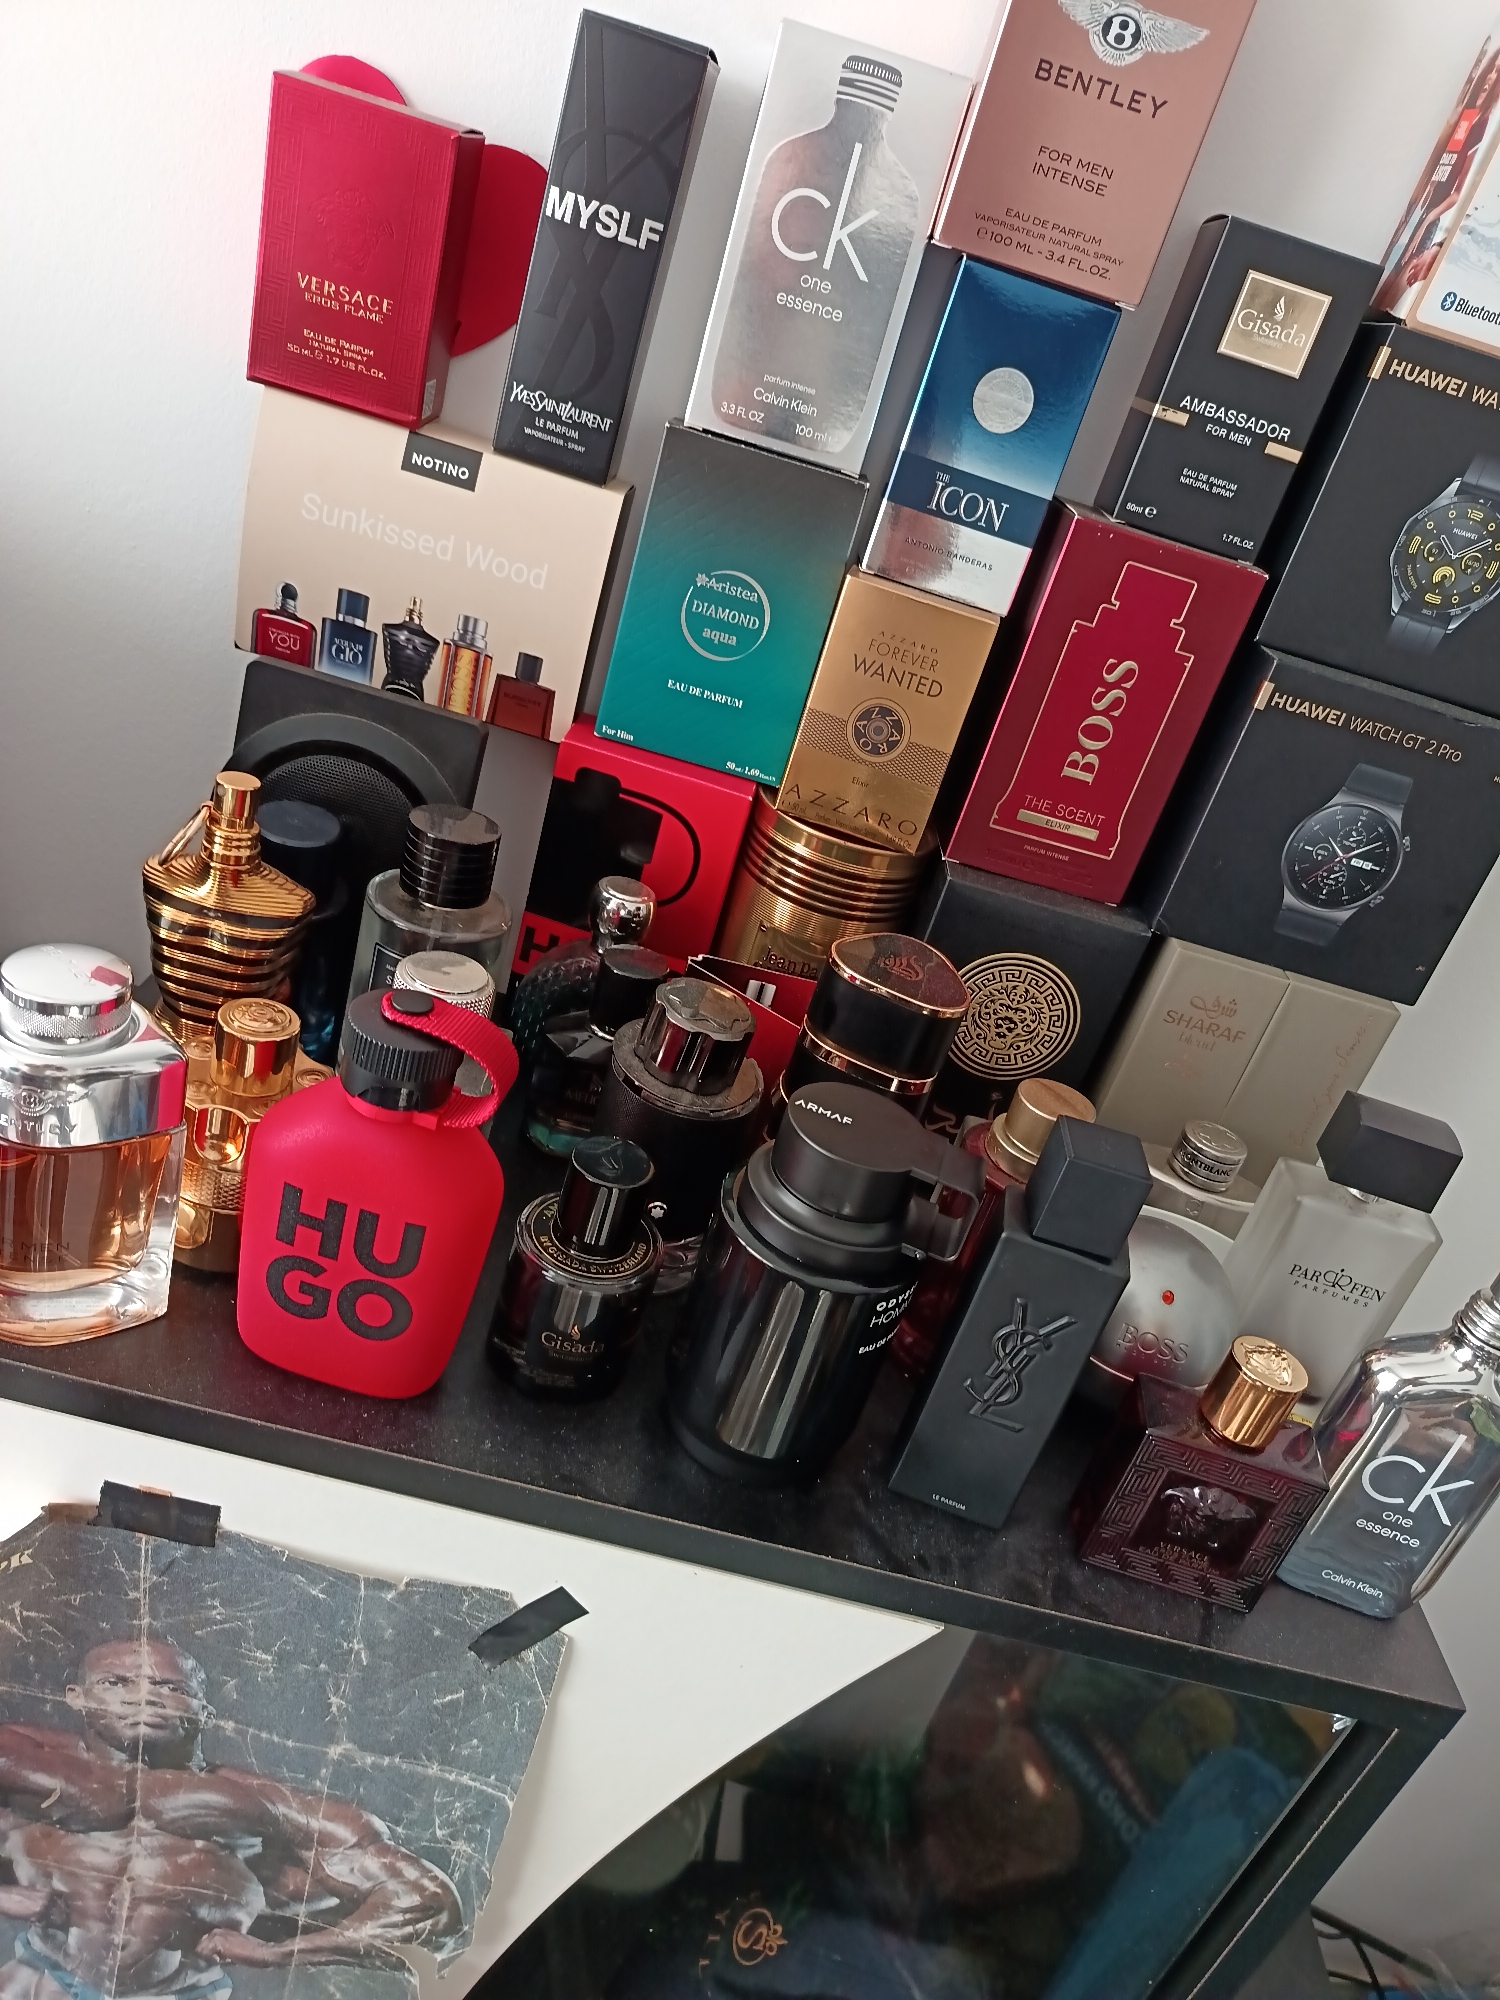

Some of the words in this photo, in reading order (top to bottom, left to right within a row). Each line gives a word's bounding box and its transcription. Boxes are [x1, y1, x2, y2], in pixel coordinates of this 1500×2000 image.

[1034, 58, 1168, 119] BENTLEY
[1037, 145, 1072, 167] FOR
[1076, 158, 1114, 180] MEN
[1032, 161, 1108, 197] INTENSE
[545, 184, 664, 251] MYSLF
[1005, 207, 1030, 223] EAU
[1032, 216, 1050, 230] DE
[1051, 222, 1102, 247] PARFUM
[974, 211, 1046, 242] VAPORISATEUR
[1048, 236, 1091, 258] NATURAL
[1093, 251, 1124, 267] SPRAY
[989, 230, 1013, 247] 100
[1015, 239, 1034, 255] ML
[1044, 249, 1065, 266] 3.4
[297, 271, 394, 316] VERSACE
[800, 274, 832, 294] one
[305, 291, 340, 311] EROS
[344, 304, 384, 325] FLAME
[776, 291, 843, 322] essence
[1454, 297, 1500, 326] Bluetoot
[304, 328, 322, 341] EAU
[324, 334, 337, 346] DE
[340, 338, 374, 358] PARFUM
[1237, 307, 1307, 349] Gisada
[287, 342, 300, 354] 50
[326, 354, 340, 367] 1.7
[341, 358, 356, 371] US
[764, 373, 790, 390] parfum
[790, 380, 816, 396] intense
[1389, 358, 1468, 398] HUAWEI
[1471, 385, 1500, 411] WA
[720, 401, 736, 415] 3.3
[737, 405, 748, 419] FL
[748, 410, 765, 424] OZ
[753, 386, 790, 411] Calvin
[790, 396, 818, 418] Klein
[535, 416, 545, 428] LE
[546, 420, 579, 440] PARFUM
[795, 423, 813, 438] 100
[814, 429, 827, 443] ml
[1179, 395, 1291, 443] AMBASSADOR
[1205, 423, 1228, 440] FOR
[1228, 431, 1252, 447] MEN
[411, 451, 470, 480] NOTINO
[935, 470, 951, 484] THE
[1182, 467, 1198, 479] EAU
[1198, 472, 1209, 482] DE
[1209, 475, 1238, 492] PARFUM
[1179, 475, 1210, 493] NATURAL
[1211, 485, 1235, 500] SPRAY
[926, 480, 1010, 533] ICON
[301, 492, 455, 562] Sunkissed
[465, 540, 549, 591] Wood
[1221, 533, 1233, 544] 1.7
[1452, 527, 1478, 541] HUAWEI
[905, 536, 945, 555] ANTONIO
[946, 550, 993, 572] BANDERAS
[706, 576, 759, 604] Aristea
[691, 599, 760, 630] DIAMOND
[269, 629, 301, 652] YOU
[702, 627, 737, 647] aqua
[878, 630, 938, 655] AZZARO
[868, 638, 939, 673] FOREVER
[853, 653, 943, 698] WANTED
[667, 679, 688, 693] EAU
[688, 685, 702, 698] DE
[703, 688, 743, 709] PARFUM
[602, 724, 616, 736] For
[617, 729, 634, 742] Him
[1061, 659, 1139, 786] BOSS
[1271, 692, 1347, 727] HUAWEI
[1349, 715, 1402, 744] WATCH
[1403, 733, 1425, 750] GT
[1425, 740, 1437, 755] 2
[1437, 743, 1462, 763] Pro
[851, 776, 870, 789] Elixir
[784, 783, 918, 836] AZZARO
[1024, 794, 1052, 813] THE
[1055, 803, 1106, 828] SCENT
[1045, 818, 1071, 832] ELIXIR
[762, 945, 798, 973] Jean
[799, 960, 819, 978] Pa
[1162, 1009, 1247, 1044] SHARAF
[1178, 1032, 1218, 1053] blend
[0, 1113, 77, 1135] ENTLEY
[795, 1098, 853, 1126] ARMAF
[1178, 1147, 1233, 1178] MONTBLANC
[275, 1181, 427, 1279] HU
[548, 1244, 588, 1272] GISADA
[265, 1254, 413, 1342] GO
[1294, 1279, 1370, 1308] PARFUMES
[541, 1331, 604, 1355] Gisada
[1117, 1323, 1189, 1364] BOSS
[941, 1494, 966, 1511] PARFUM
[1355, 1518, 1420, 1548] essence
[1382, 1509, 1413, 1528] one
[1159, 1541, 1211, 1562] VERSACE
[1321, 1568, 1356, 1588] Calvin
[1356, 1580, 1384, 1599] Klein
